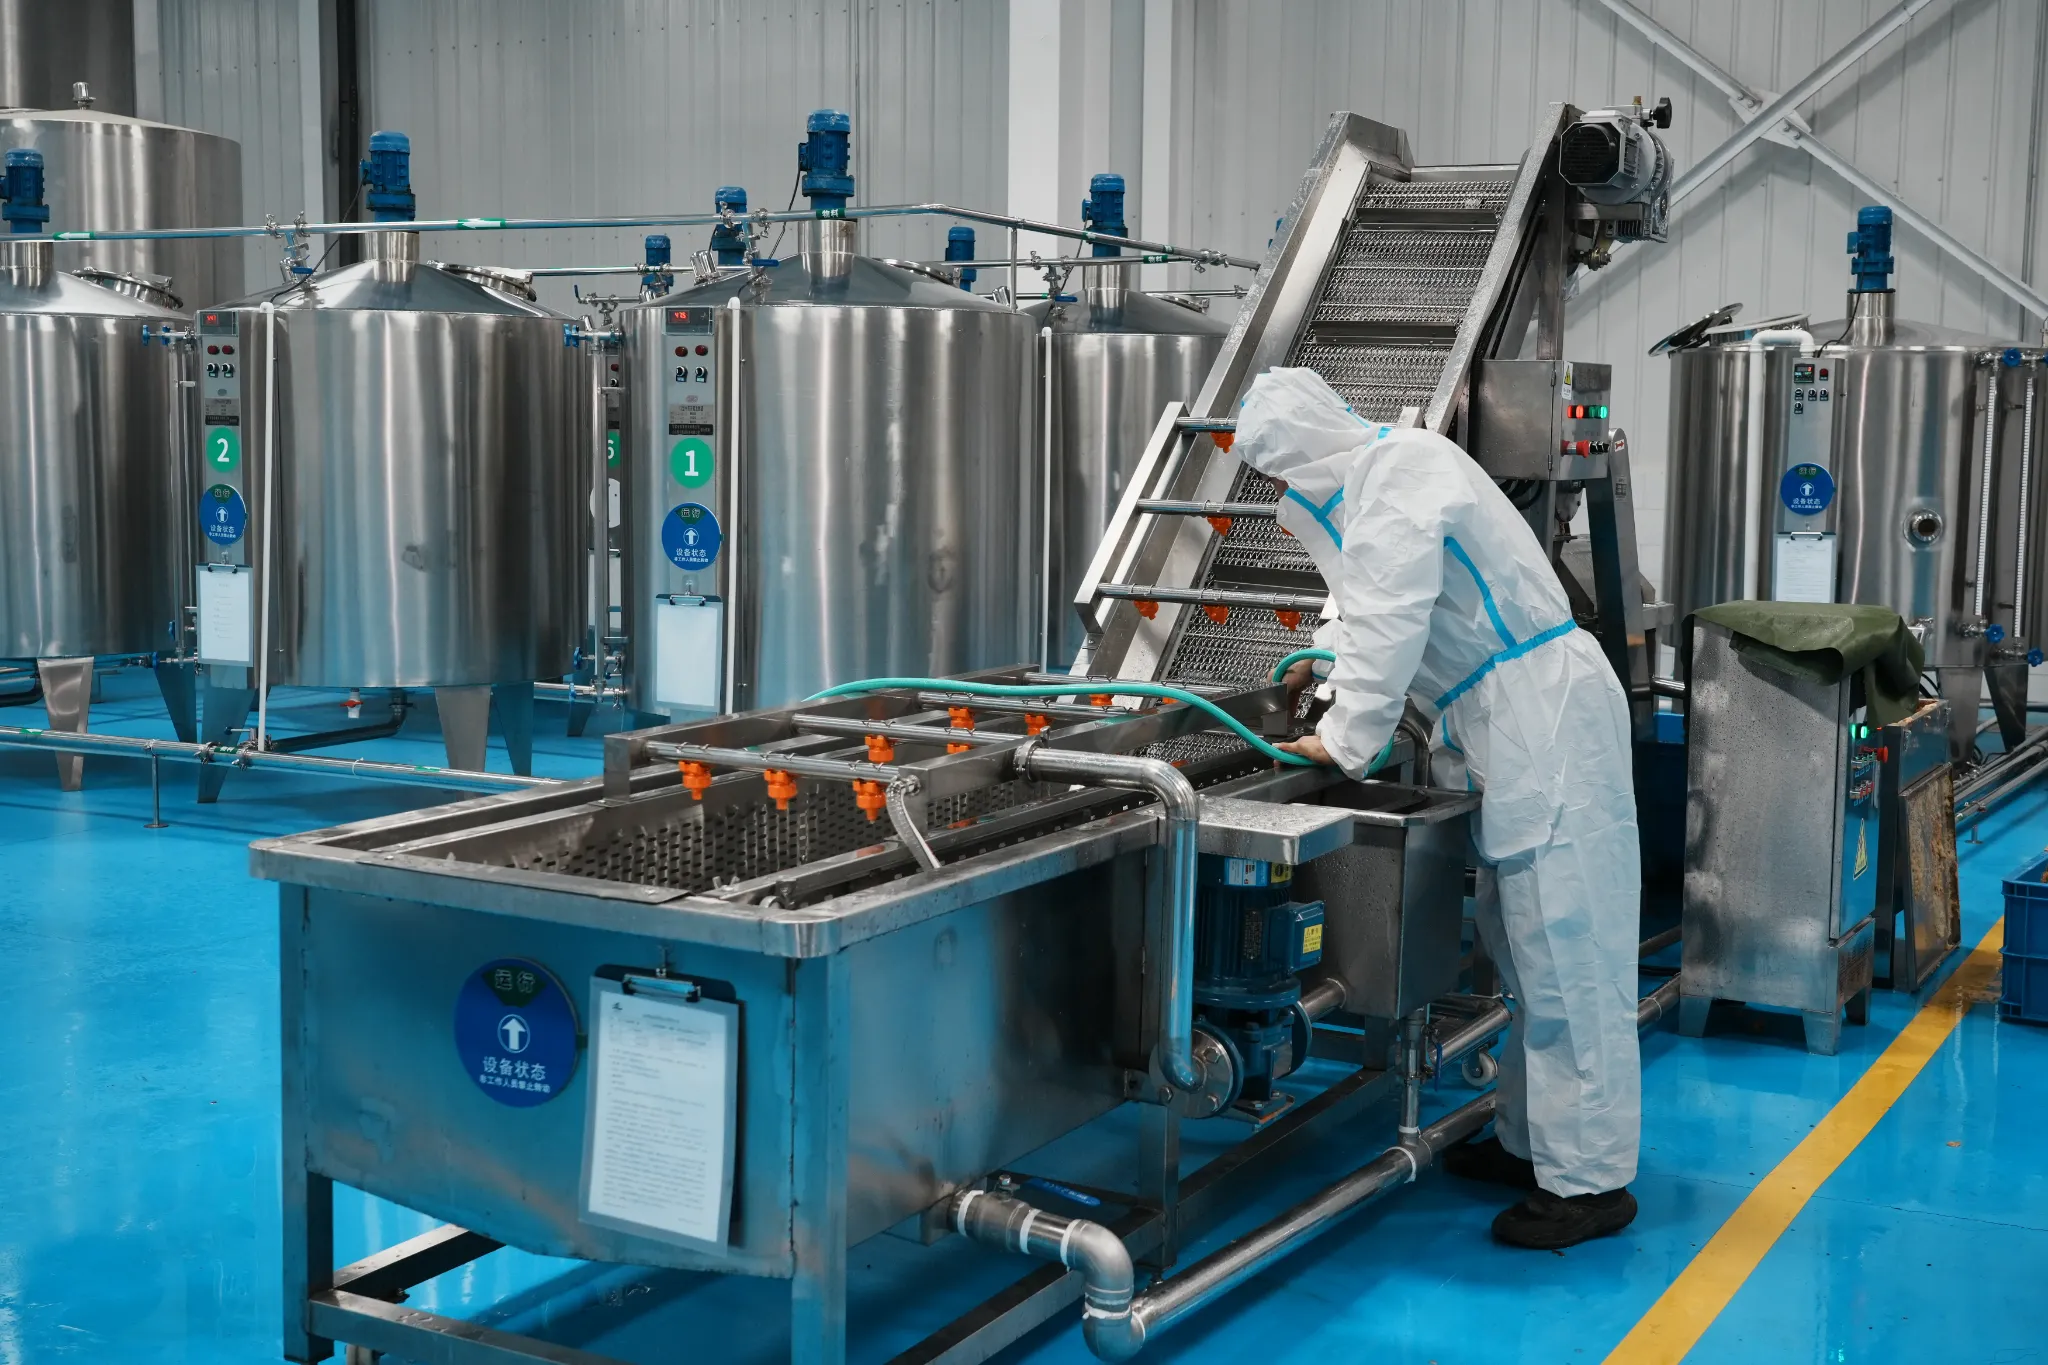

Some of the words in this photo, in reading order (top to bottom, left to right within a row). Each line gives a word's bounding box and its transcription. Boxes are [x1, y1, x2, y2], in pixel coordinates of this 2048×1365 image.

[217, 438, 230, 463] 2
[684, 449, 699, 477] 1
[210, 524, 235, 534] 设备状态
[675, 547, 707, 558] 设备状态
[494, 968, 536, 994] 运行
[482, 1055, 546, 1081] 设备状态
